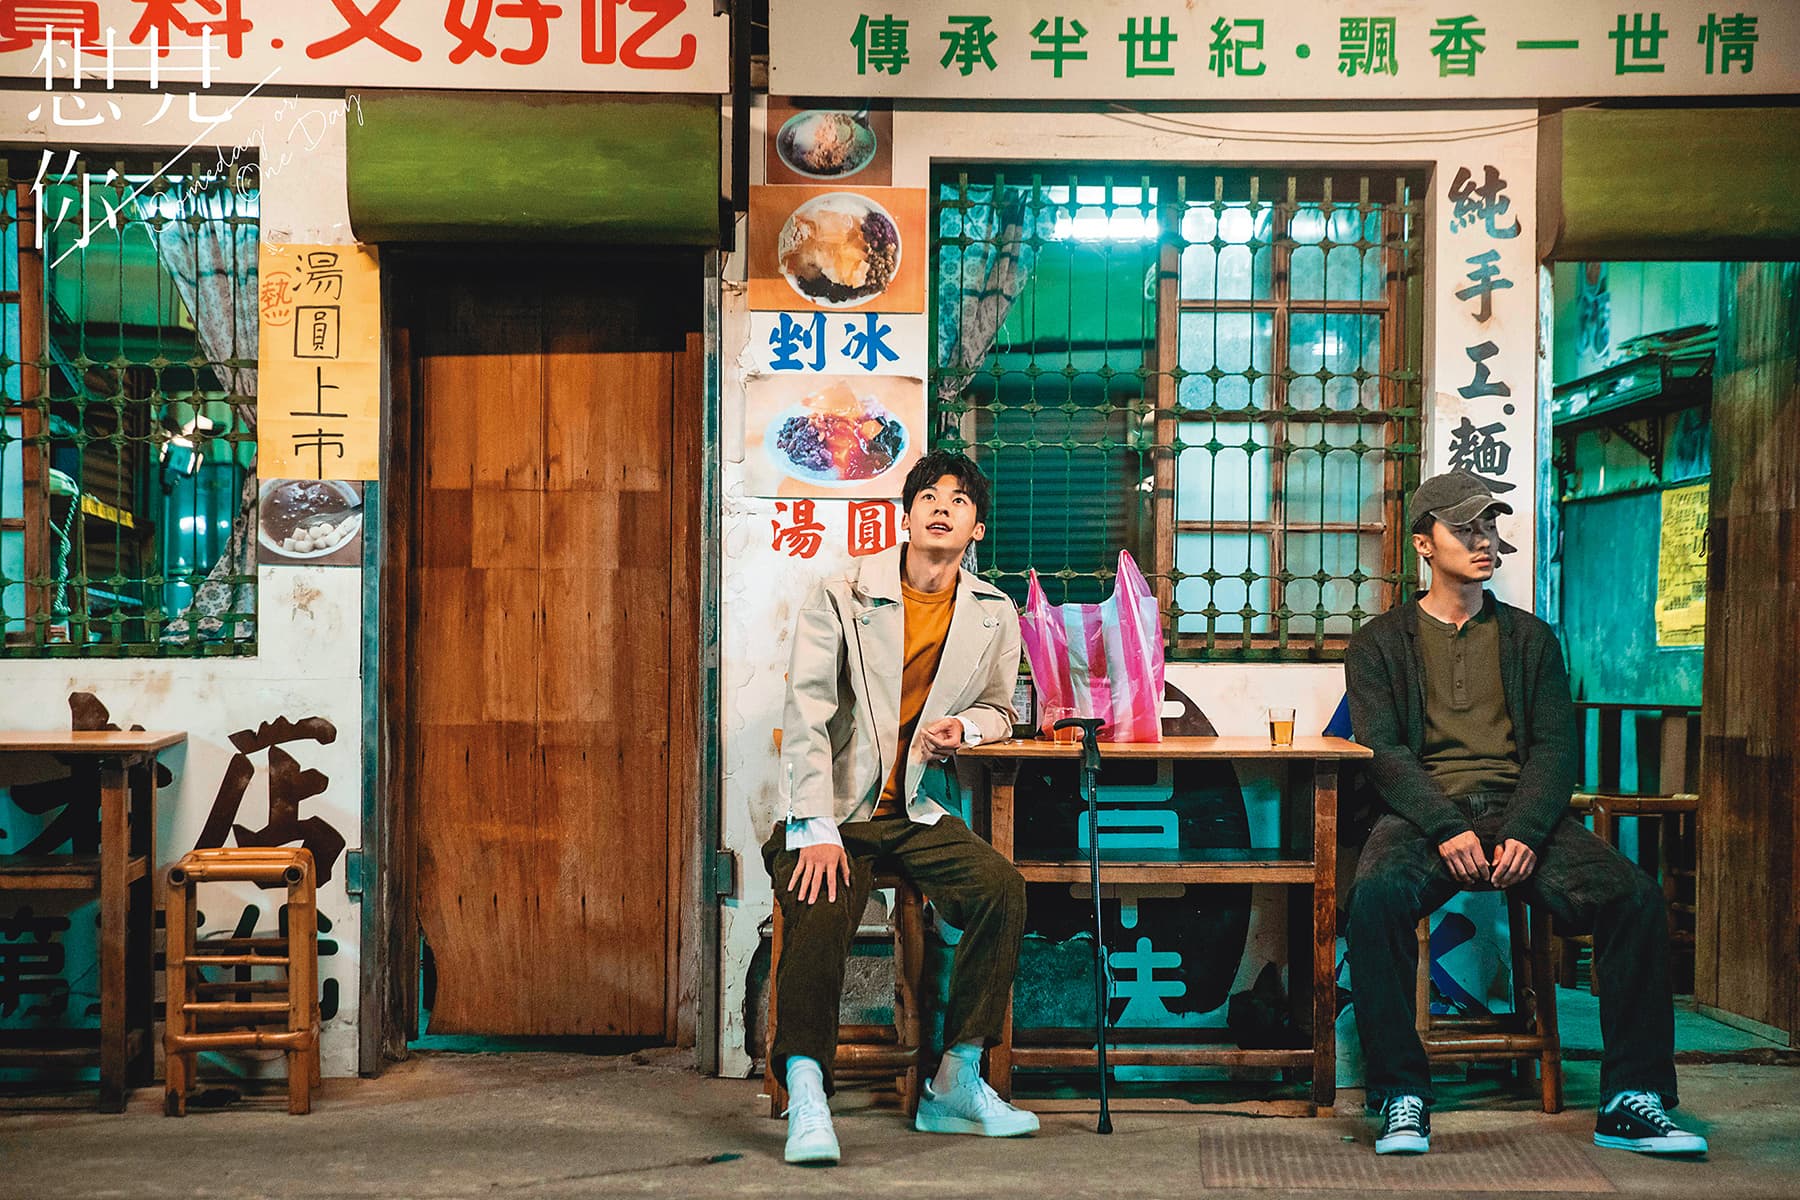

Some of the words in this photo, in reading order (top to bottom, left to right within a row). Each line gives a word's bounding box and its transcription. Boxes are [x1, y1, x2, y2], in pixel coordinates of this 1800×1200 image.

[290, 252, 348, 480] 湯圓上市
[768, 312, 900, 372] 剉冰
[771, 499, 897, 559] 湯圓
